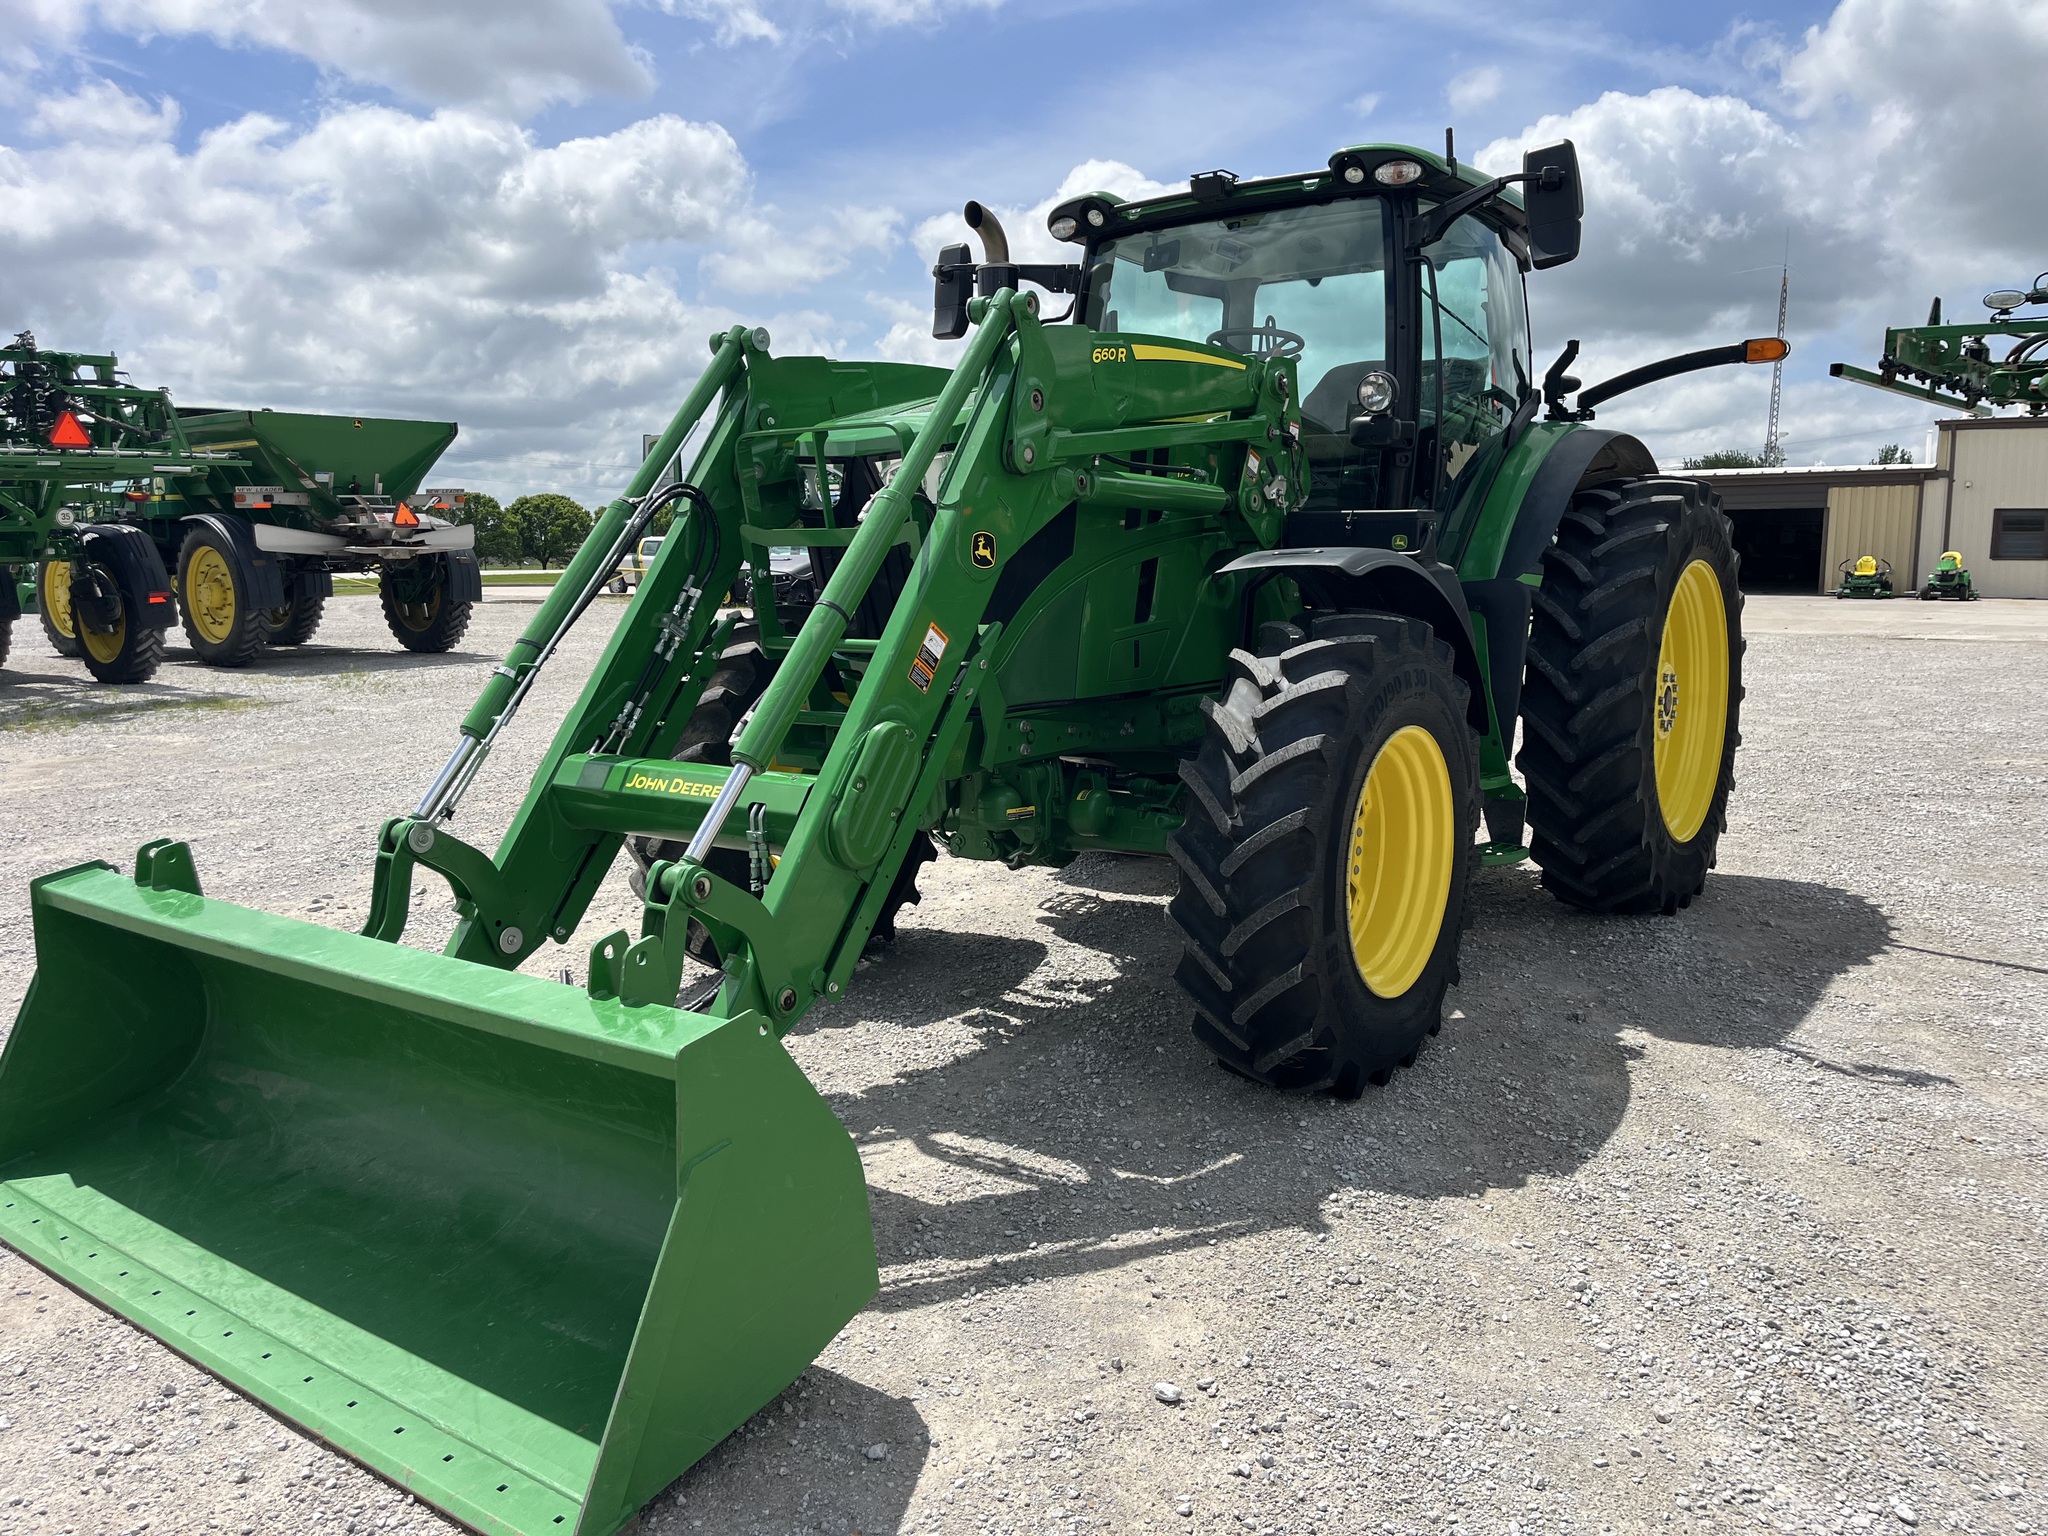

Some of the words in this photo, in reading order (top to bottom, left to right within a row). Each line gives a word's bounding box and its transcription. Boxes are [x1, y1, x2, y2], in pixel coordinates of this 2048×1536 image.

[61, 512, 71, 521] 35
[625, 773, 669, 793] JOHN
[668, 778, 723, 798] DEERE
